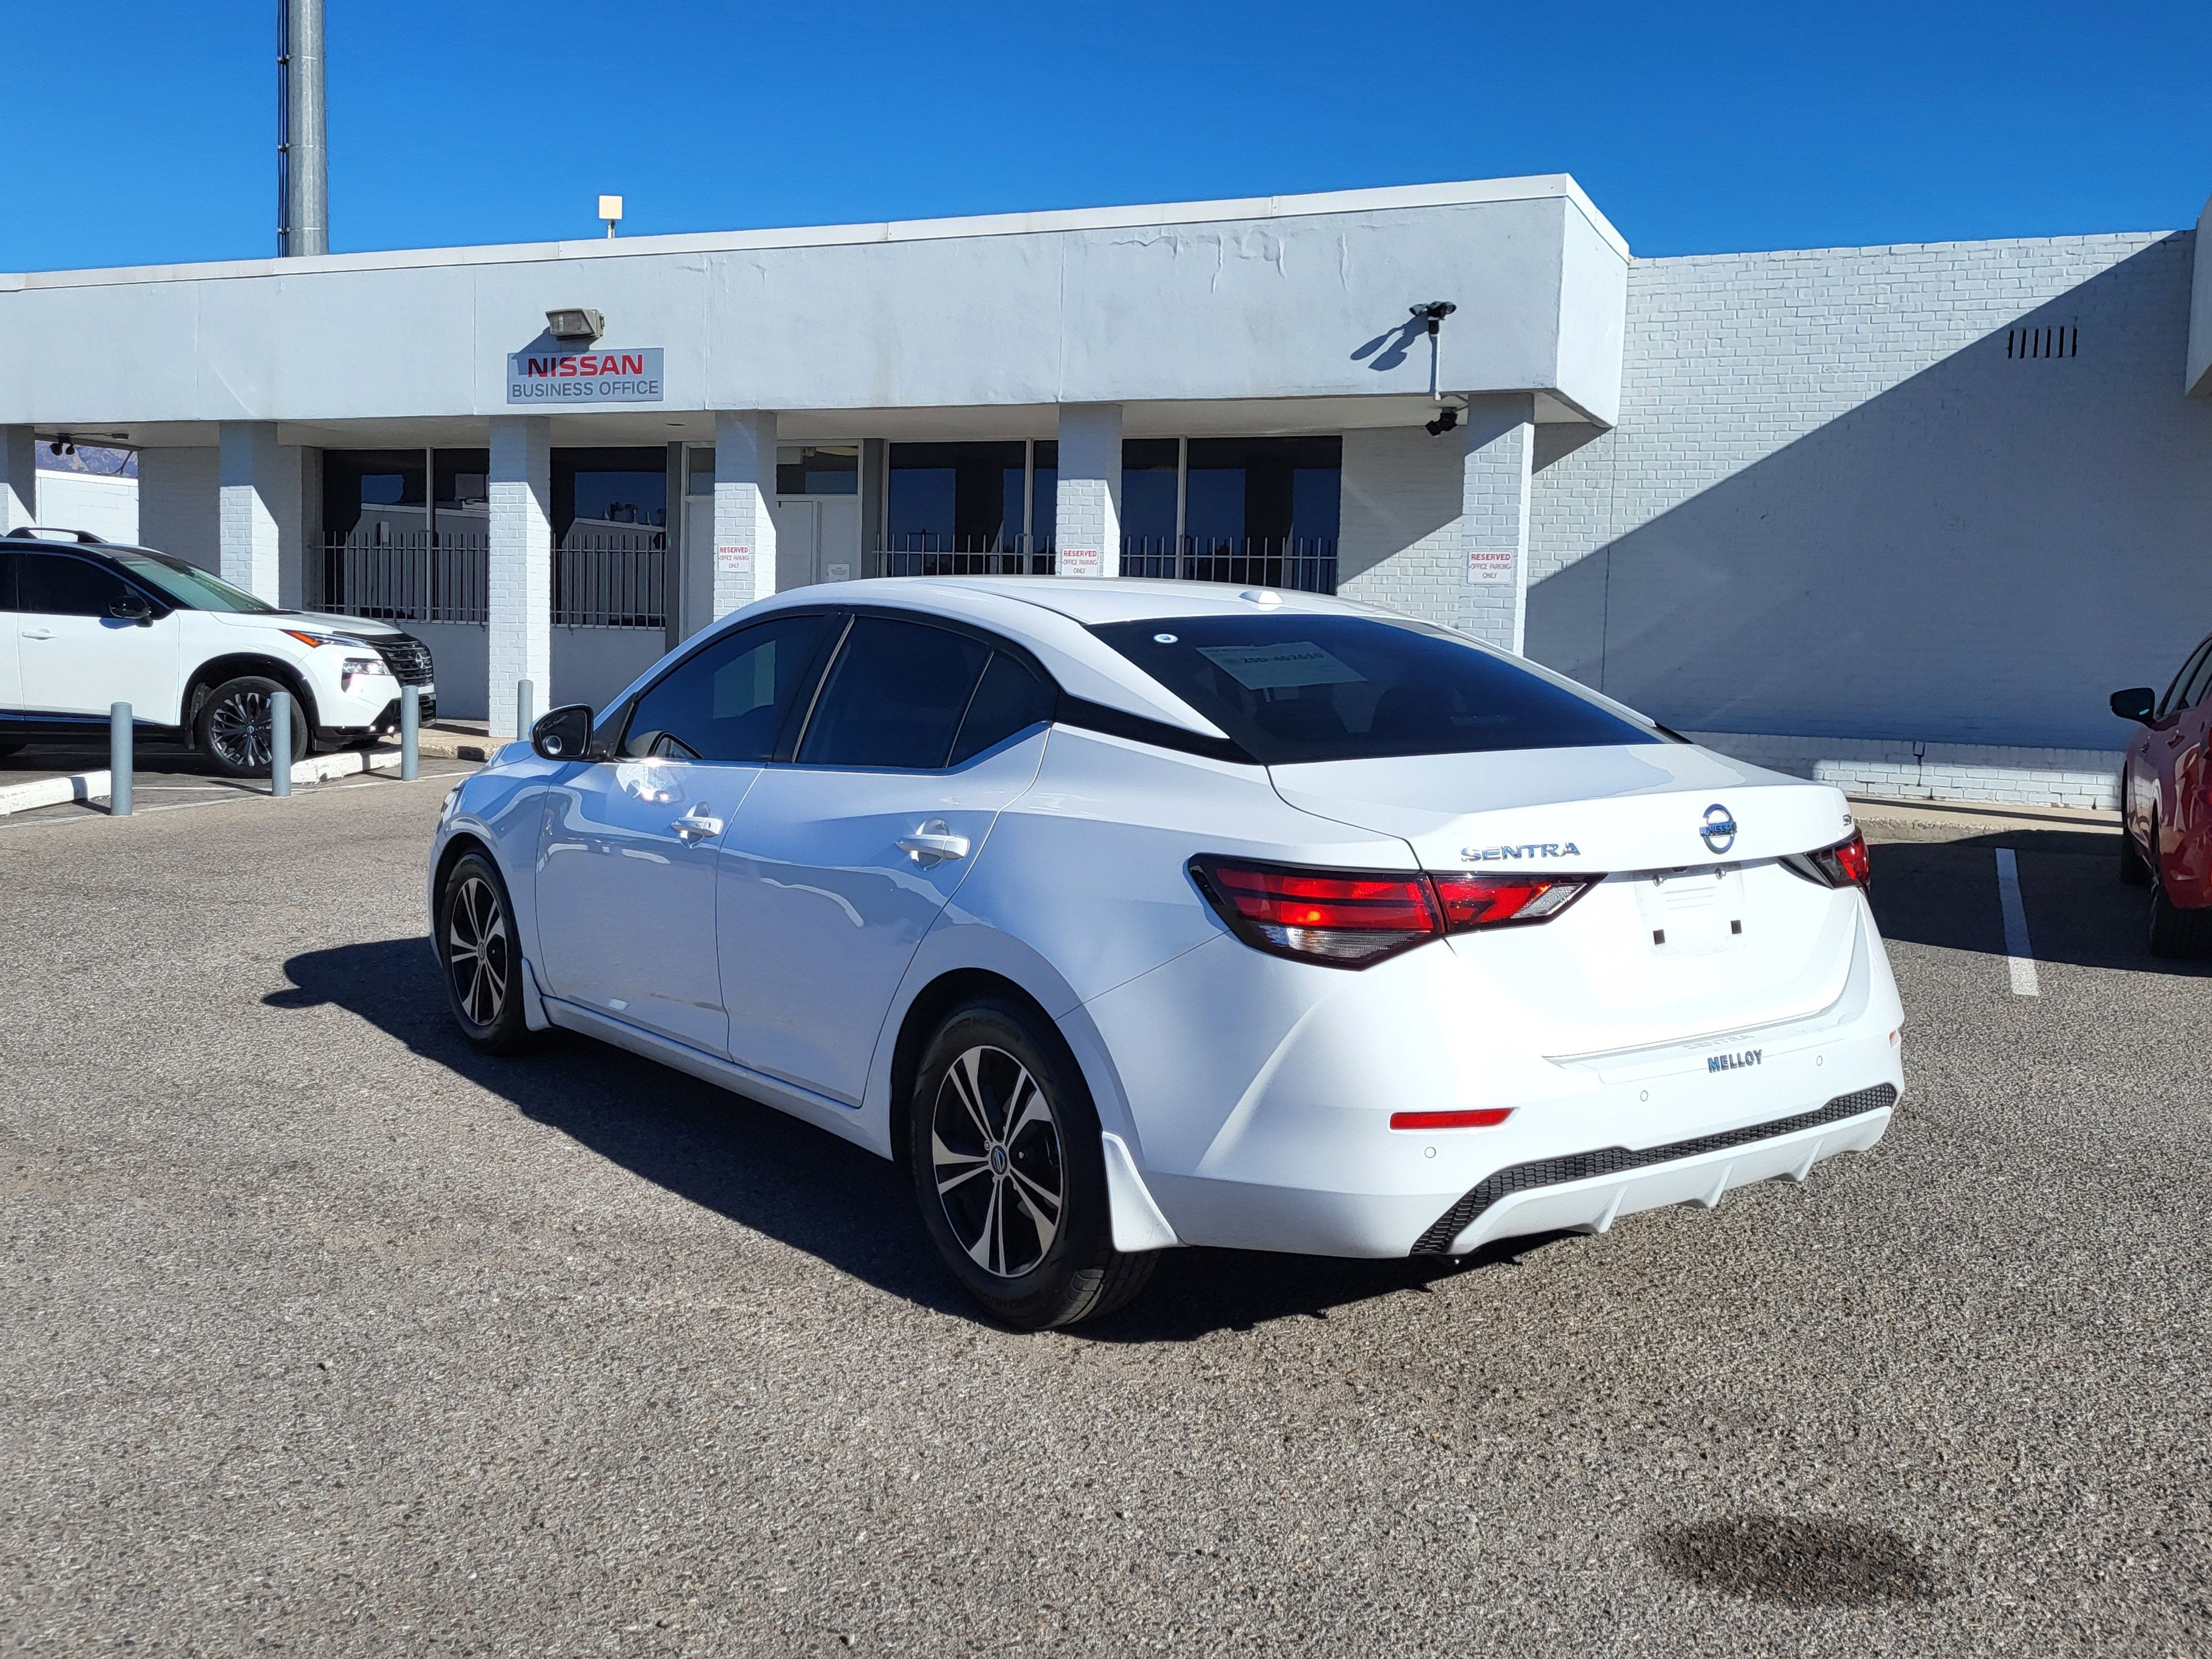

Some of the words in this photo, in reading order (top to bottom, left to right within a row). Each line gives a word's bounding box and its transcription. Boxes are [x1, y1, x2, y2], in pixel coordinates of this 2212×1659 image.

[528, 354, 643, 377] NISSAN
[512, 382, 594, 398] BUSINESS
[599, 380, 659, 395] OFFICE
[1461, 842, 1581, 862] SENTRA
[1707, 1049, 1762, 1073] MELLOY
